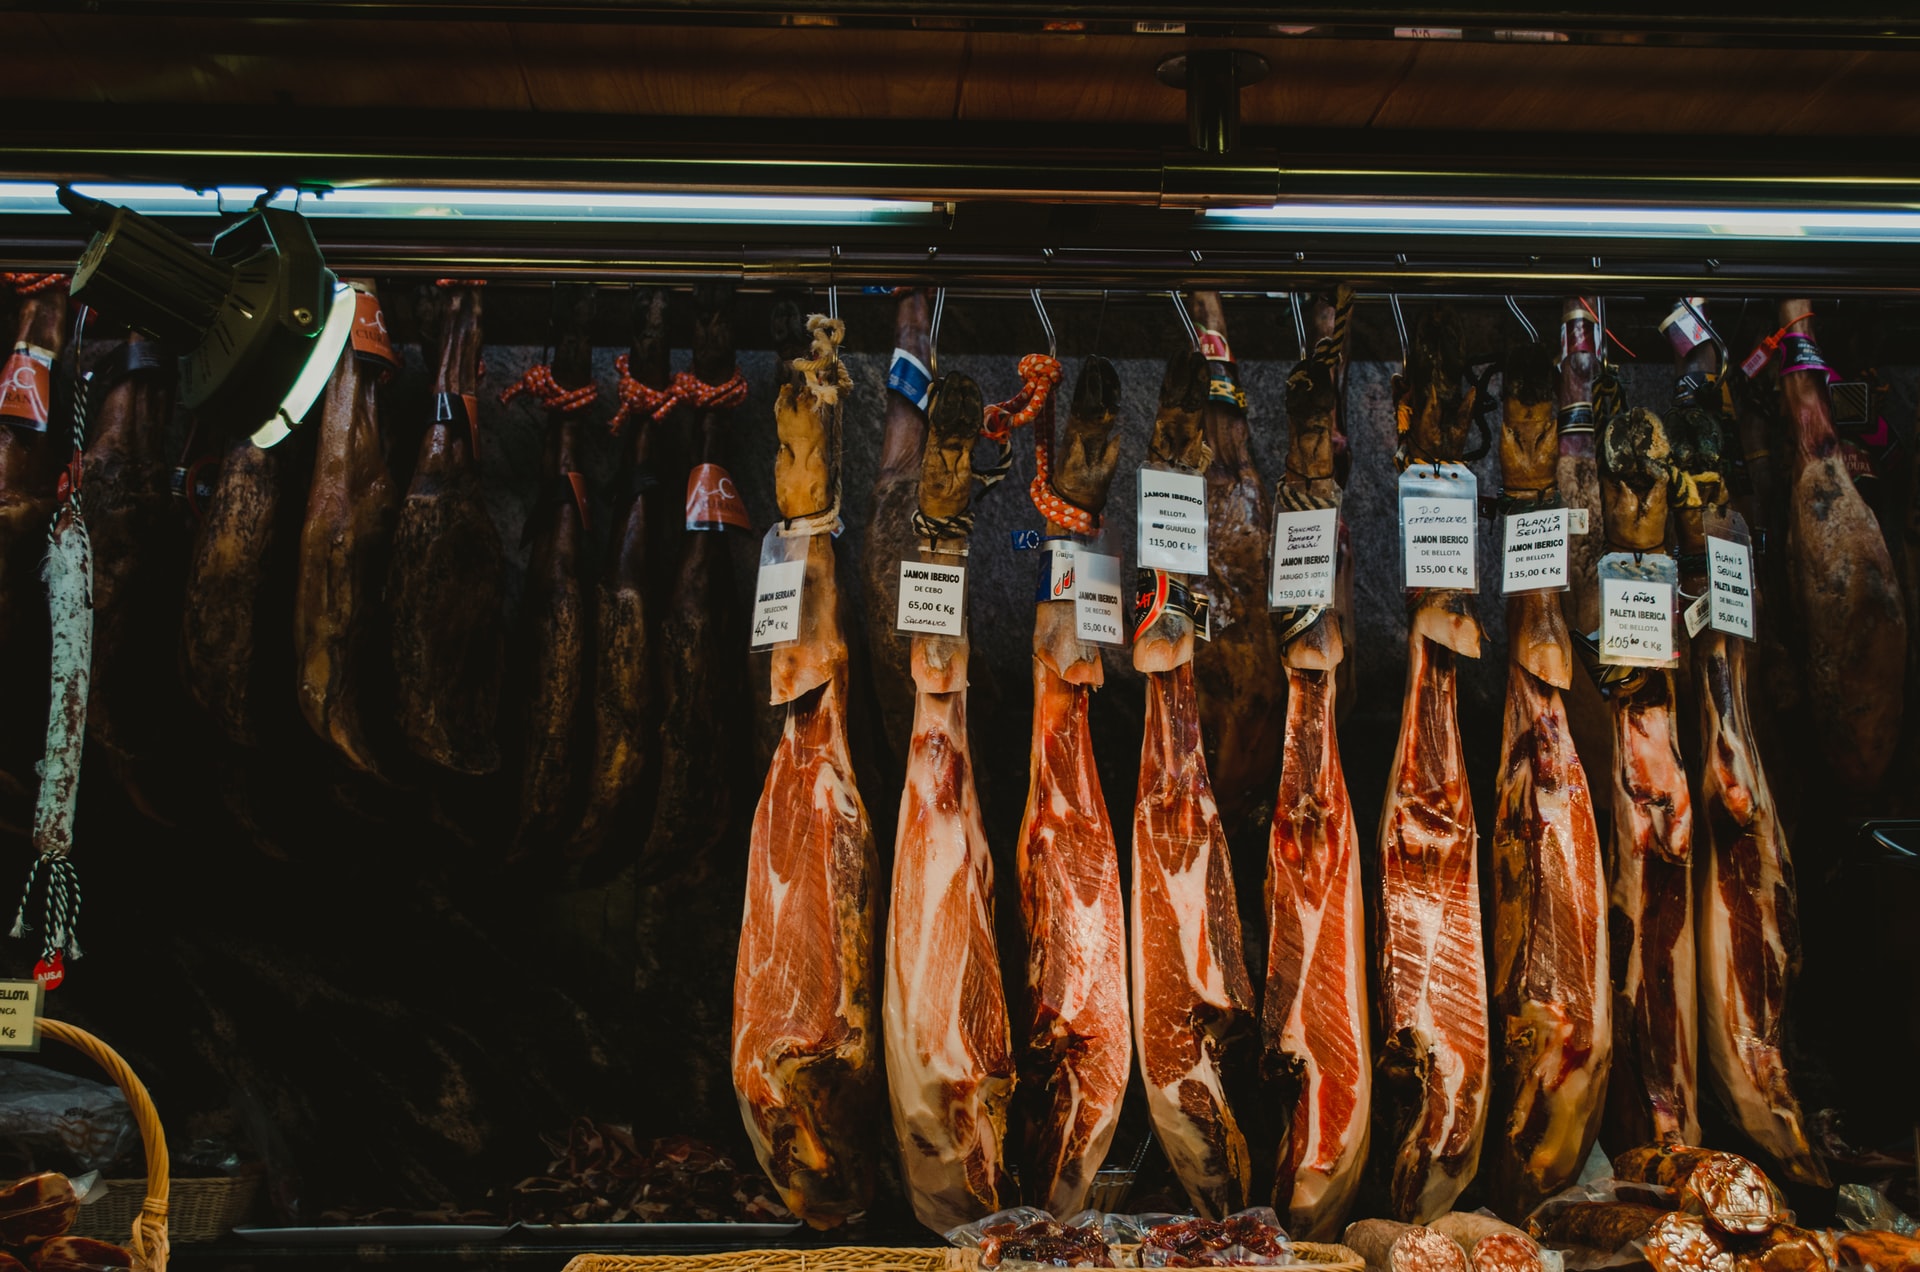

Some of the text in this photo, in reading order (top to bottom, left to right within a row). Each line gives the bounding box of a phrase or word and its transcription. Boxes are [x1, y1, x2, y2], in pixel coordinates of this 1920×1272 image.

[1144, 491, 1203, 506] JAMON IBERICO
[1159, 509, 1187, 518] BELLOTA
[1149, 538, 1178, 550] 115,00
[1180, 542, 1186, 550] €
[1412, 535, 1469, 545] JAMON IBERICO
[1507, 539, 1564, 553] JAMON IBERICO
[1281, 555, 1330, 567] JAMON IBERICO
[1526, 553, 1555, 561] BELLOTA
[903, 569, 960, 583] JAMON IBERICO
[1415, 565, 1468, 575] 155,00 € Kg
[1508, 566, 1561, 579] 135,00 € Kg
[758, 589, 797, 603] JAMON SERRANO
[924, 586, 943, 594] CEBO
[1280, 590, 1306, 599] 159,00
[1307, 589, 1313, 597] €
[1078, 591, 1118, 604] JAMON IBERICO
[1620, 591, 1629, 604] 4
[908, 600, 934, 611] 65,00
[944, 604, 955, 615] Kg
[1610, 608, 1666, 621] PALETA IBERICA
[1083, 622, 1102, 633] 85,00
[1102, 624, 1107, 633] €
[1630, 624, 1659, 632] BELLOTA
[1643, 640, 1649, 648] €
[1650, 641, 1662, 651] Kg
[0, 989, 29, 1001] ELLOTA
[0, 1007, 17, 1015] NCA
[2, 1026, 16, 1039] Kg
